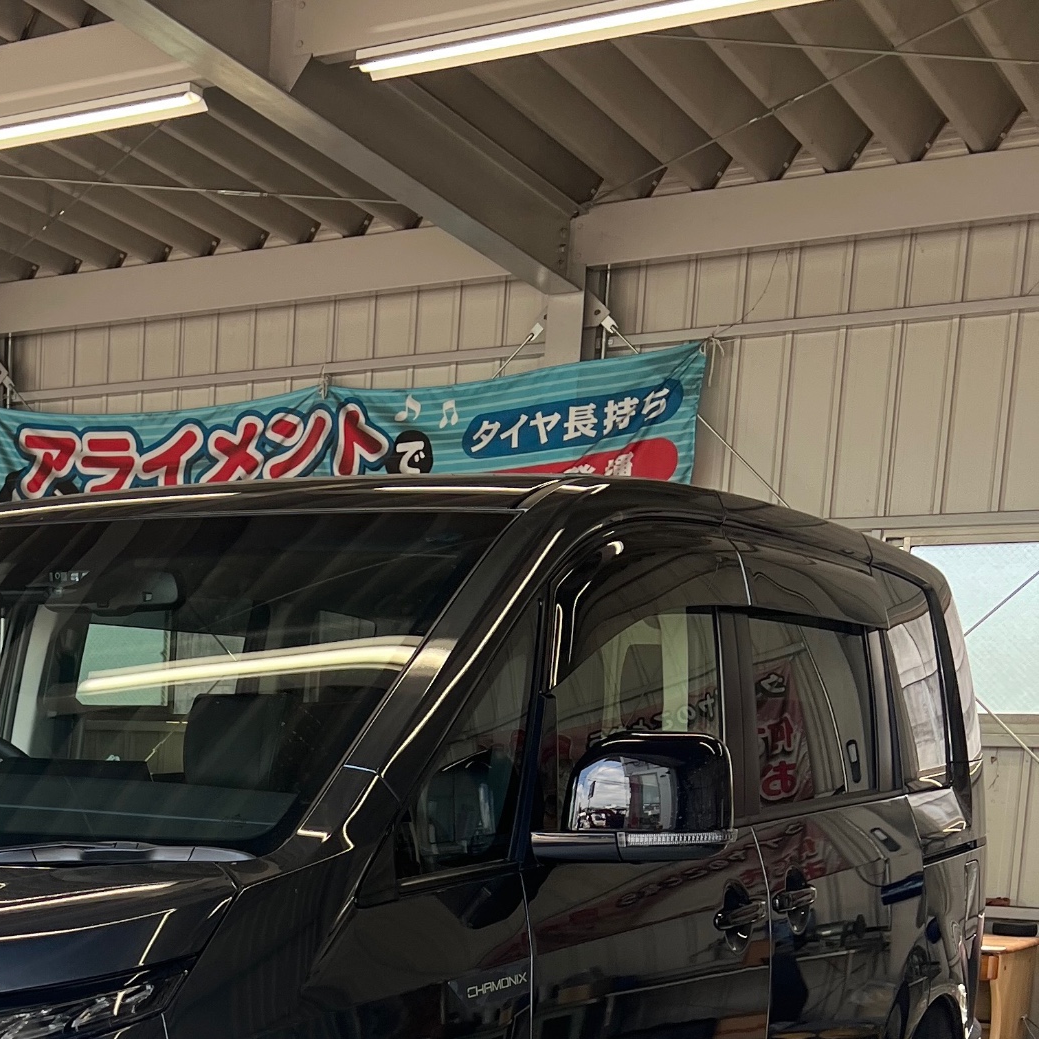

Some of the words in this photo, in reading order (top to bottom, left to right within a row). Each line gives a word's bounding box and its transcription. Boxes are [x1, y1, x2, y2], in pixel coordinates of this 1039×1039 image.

[471, 387, 670, 453] タイヤ長持ち
[467, 971, 528, 999] CHAMONIX
